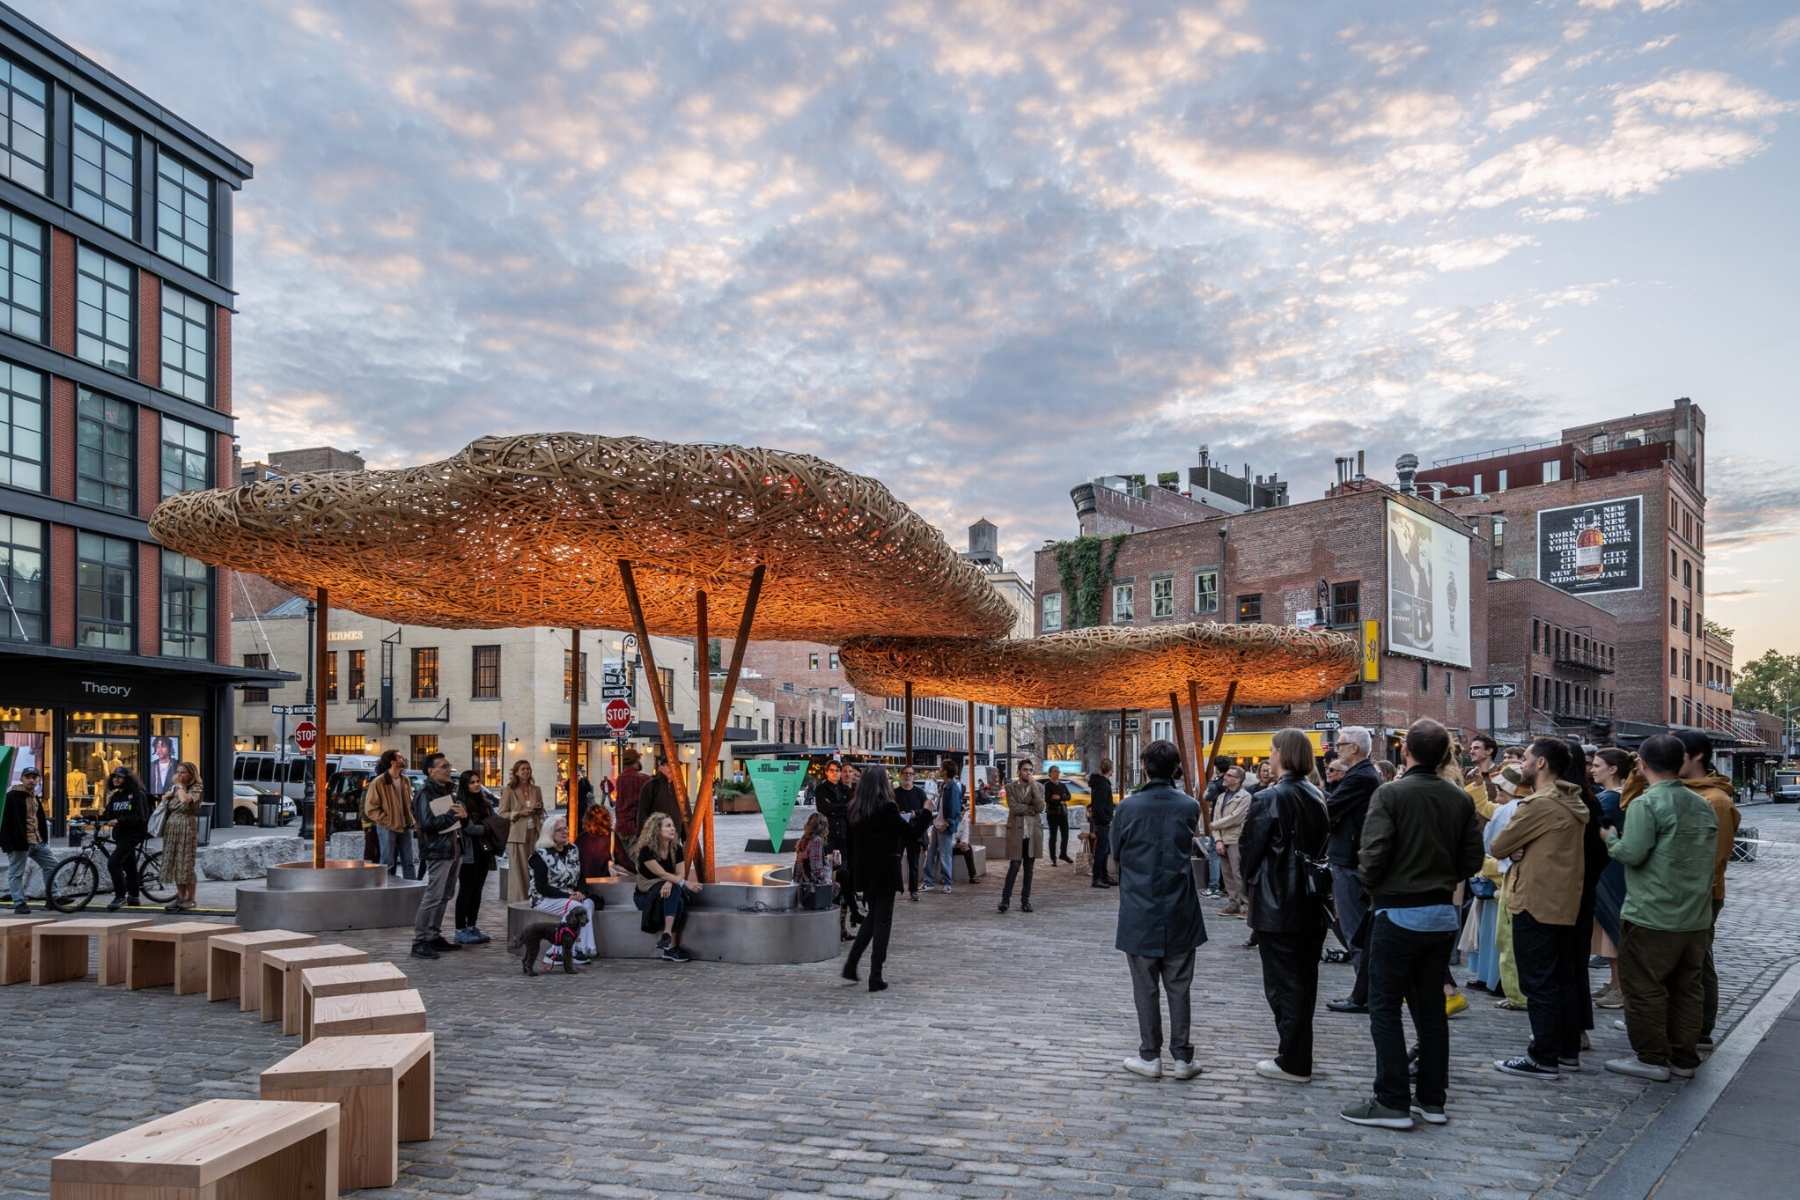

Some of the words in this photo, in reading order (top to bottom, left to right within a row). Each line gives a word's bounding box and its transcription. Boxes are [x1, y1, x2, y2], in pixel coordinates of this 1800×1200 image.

[1603, 505, 1626, 513] NEW
[1573, 514, 1601, 523] YOK
[1603, 511, 1626, 519] NEW
[1572, 521, 1601, 530] YOK
[1604, 518, 1626, 526] NEW
[1549, 531, 1576, 539] YORK
[1604, 524, 1626, 532] NEW
[1549, 537, 1576, 545] YORK
[1603, 529, 1631, 537] YORK
[1549, 544, 1576, 552] YORK
[1603, 536, 1631, 544] YORK
[1603, 550, 1628, 558] CITY
[1603, 557, 1628, 565] CITY
[81, 681, 131, 697] Theory
[607, 708, 629, 720] STOP
[296, 730, 317, 741] STOP
